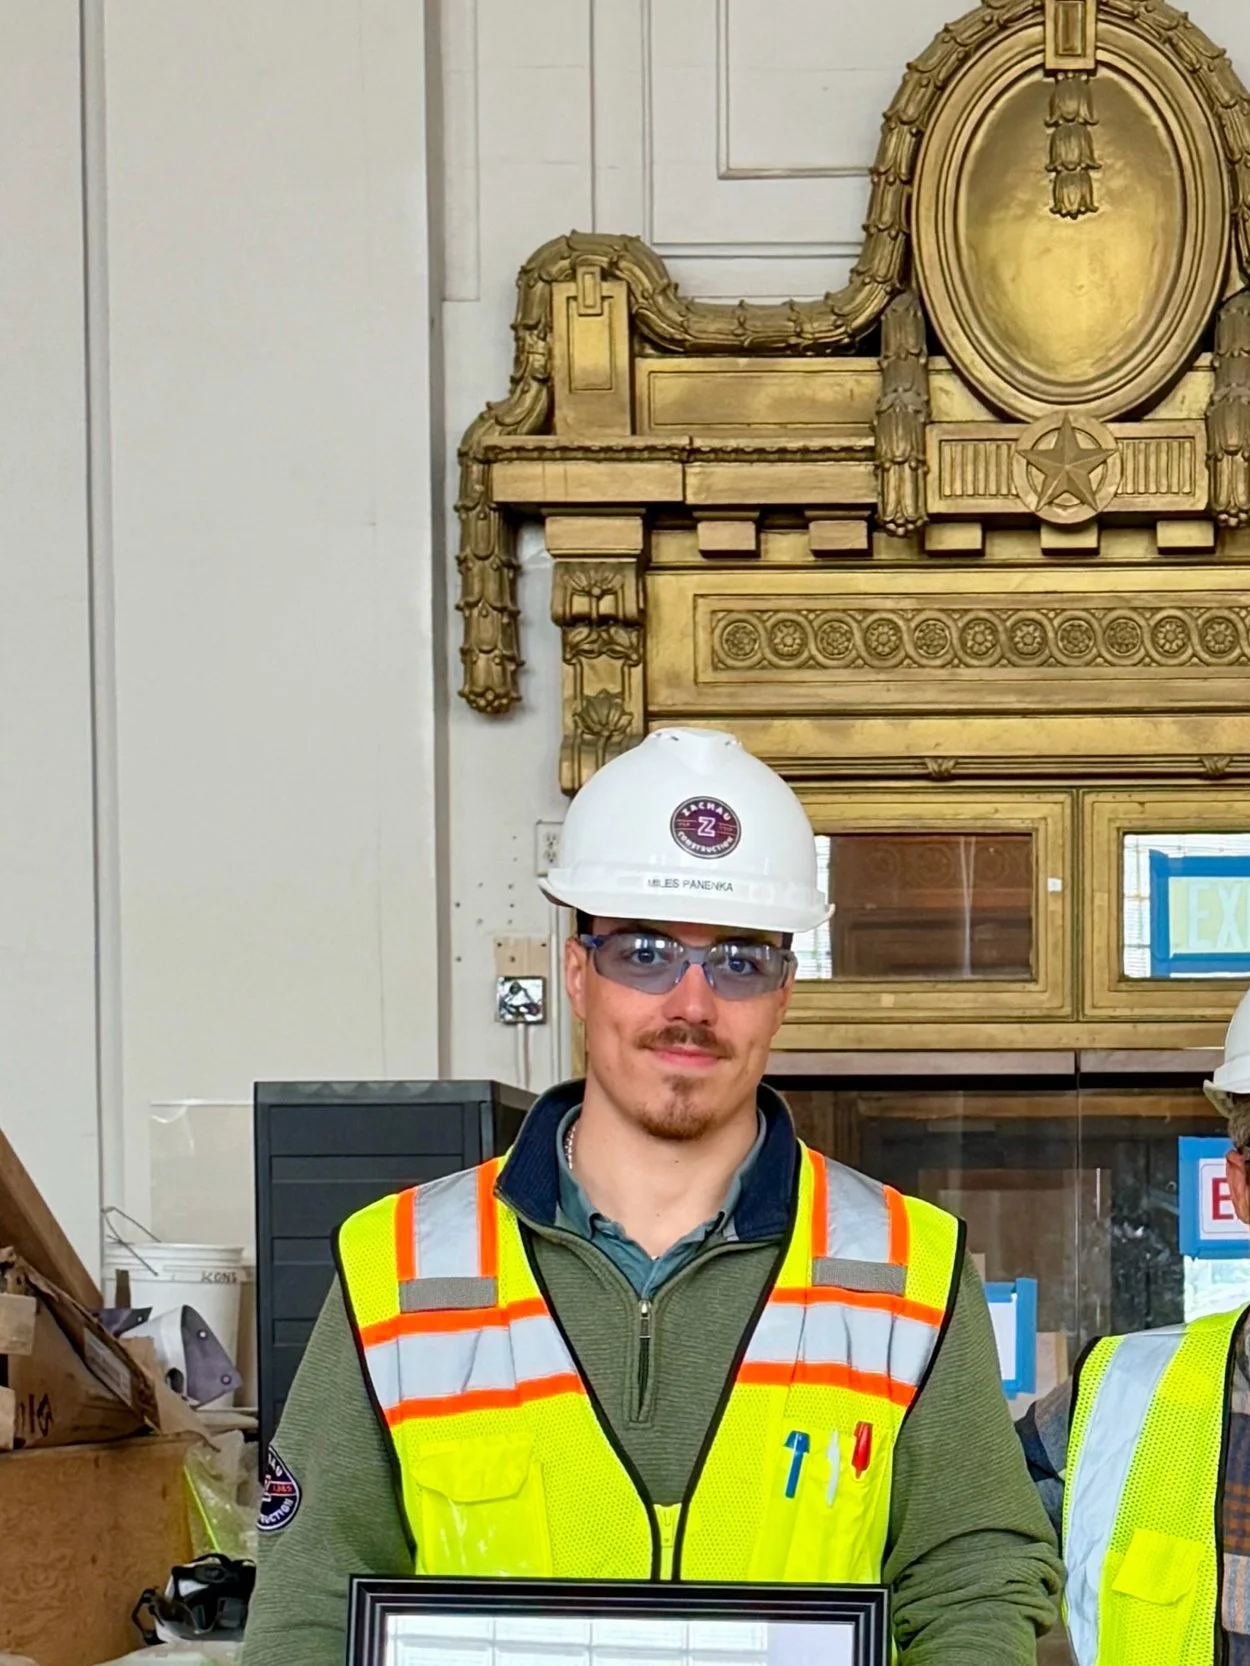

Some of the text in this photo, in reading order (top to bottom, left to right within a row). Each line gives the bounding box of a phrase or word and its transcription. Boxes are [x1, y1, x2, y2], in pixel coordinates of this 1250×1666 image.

[681, 802, 732, 821] ZACHAU
[697, 816, 716, 837] Z
[678, 831, 734, 853] CONSTRUCTION
[682, 880, 734, 892] PANENKA
